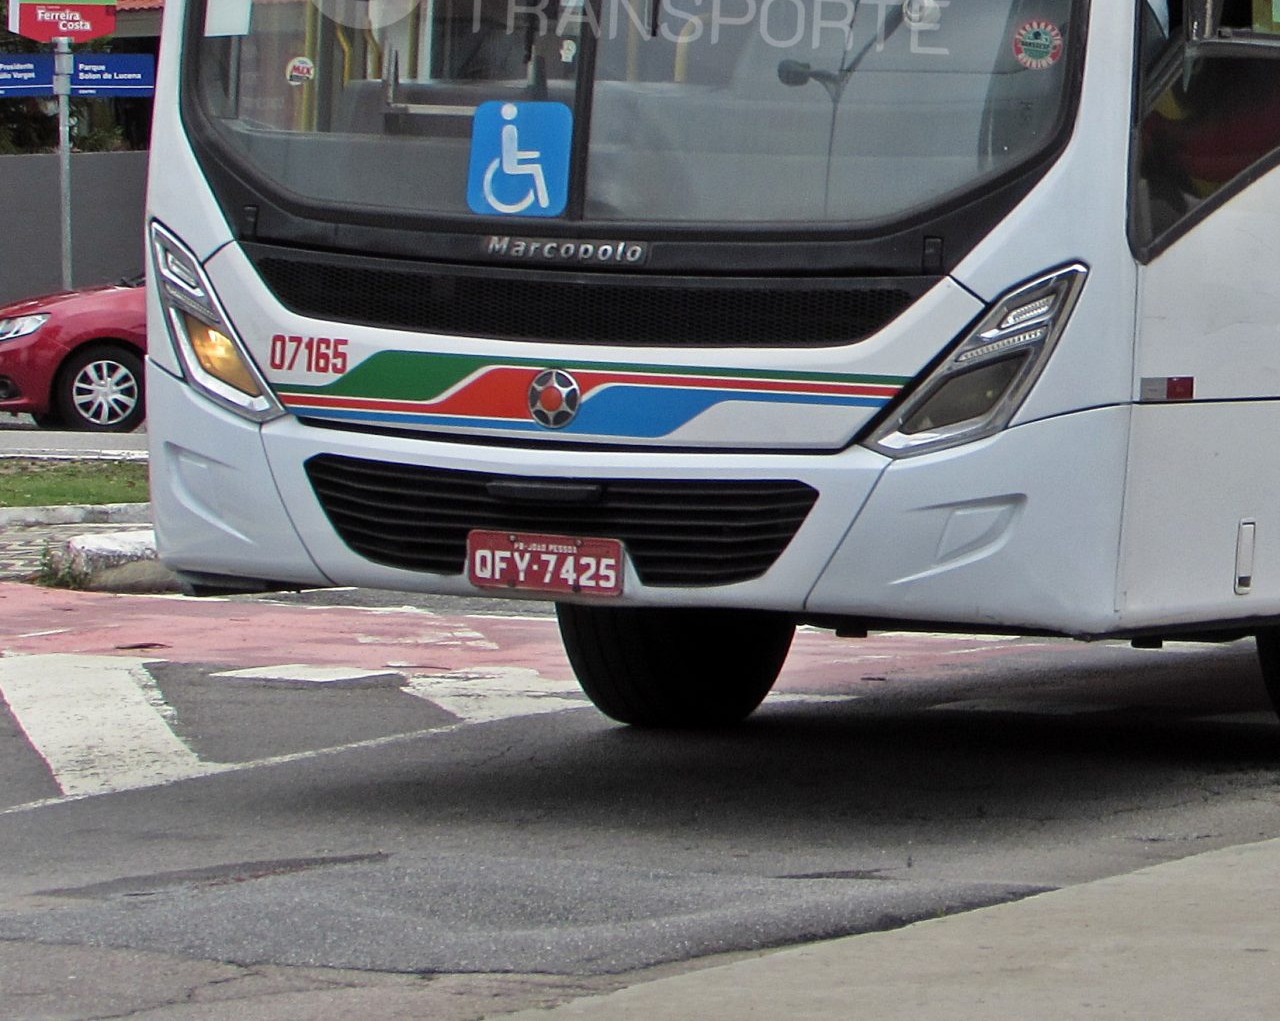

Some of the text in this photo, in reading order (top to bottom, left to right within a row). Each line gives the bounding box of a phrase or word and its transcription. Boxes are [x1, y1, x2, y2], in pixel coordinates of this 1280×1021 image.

[36, 9, 81, 21] Ferreira
[59, 20, 92, 31] Costa
[79, 63, 106, 72] Parque
[114, 72, 142, 80] Lucena
[486, 234, 644, 264] Marcopolo
[270, 333, 349, 376] 07165
